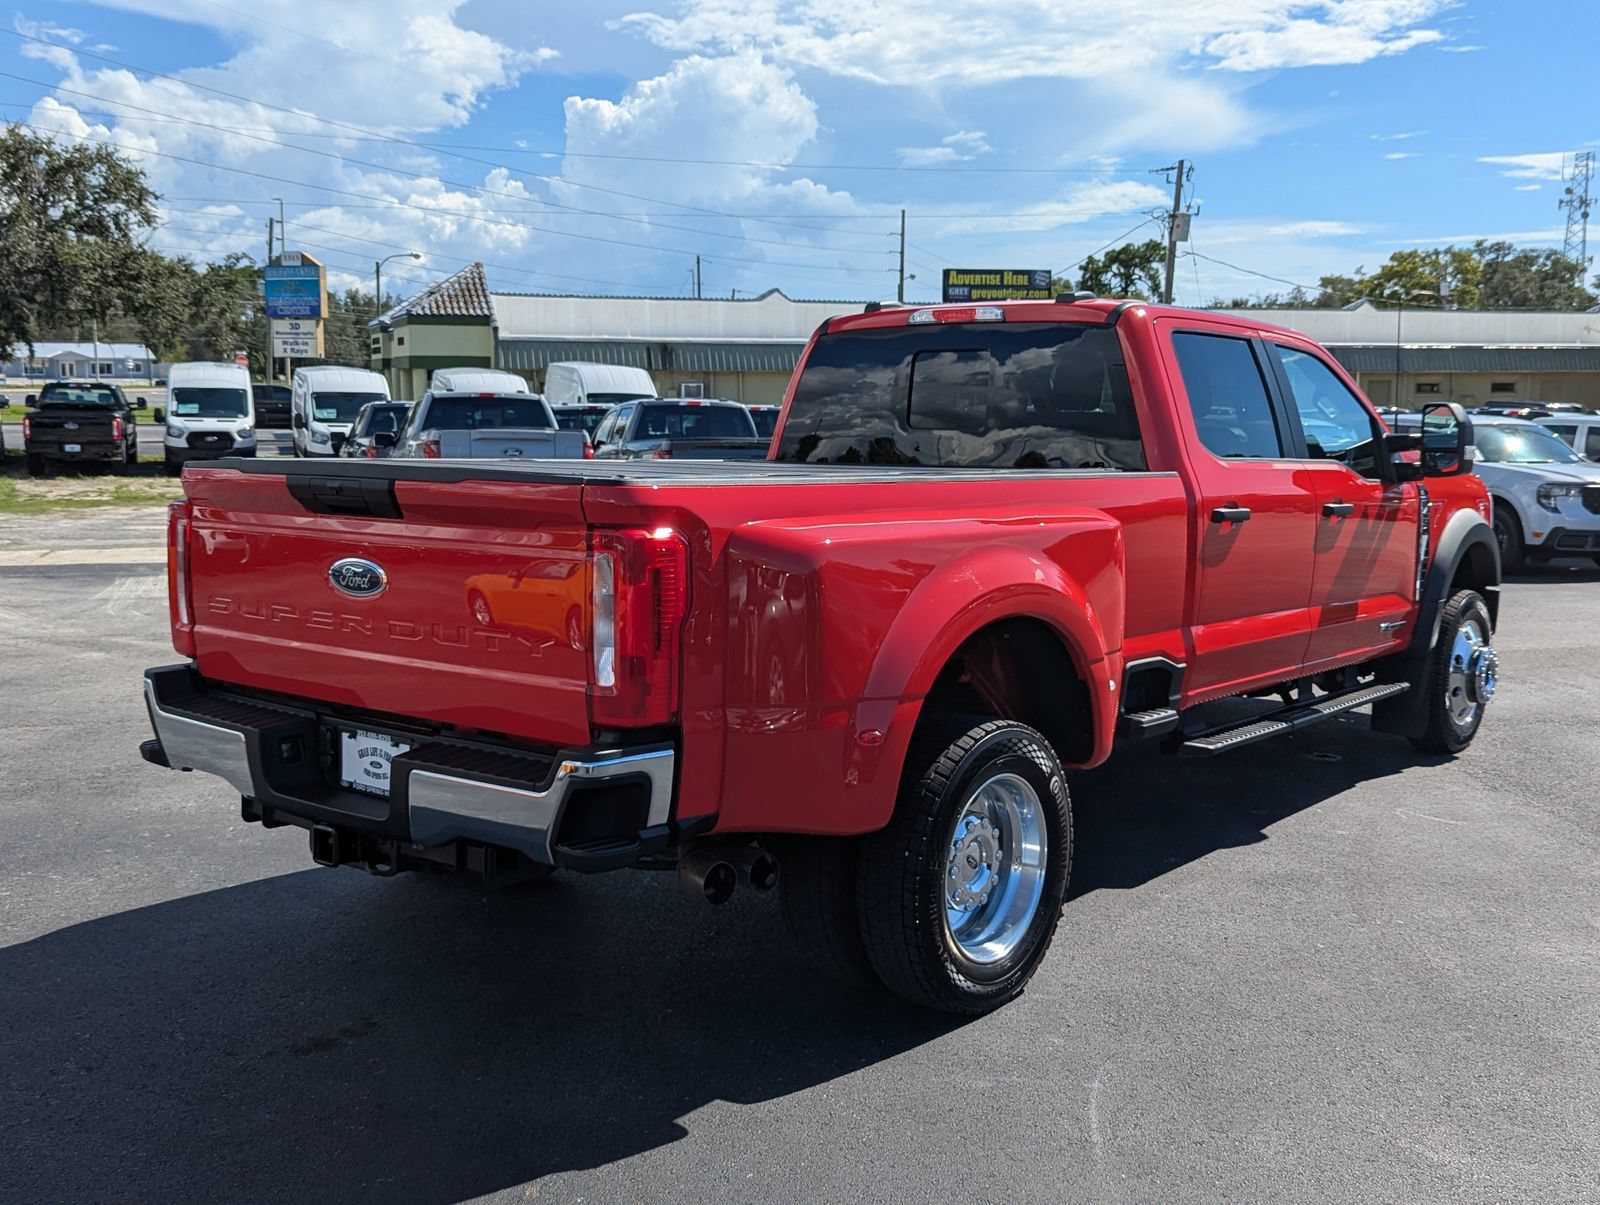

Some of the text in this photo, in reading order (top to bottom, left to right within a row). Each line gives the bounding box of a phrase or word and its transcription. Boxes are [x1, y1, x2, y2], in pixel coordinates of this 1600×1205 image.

[288, 322, 301, 330] 3D
[290, 348, 309, 356] Rays
[339, 565, 372, 589] Ford
[208, 596, 556, 657] SUPER DUTY
